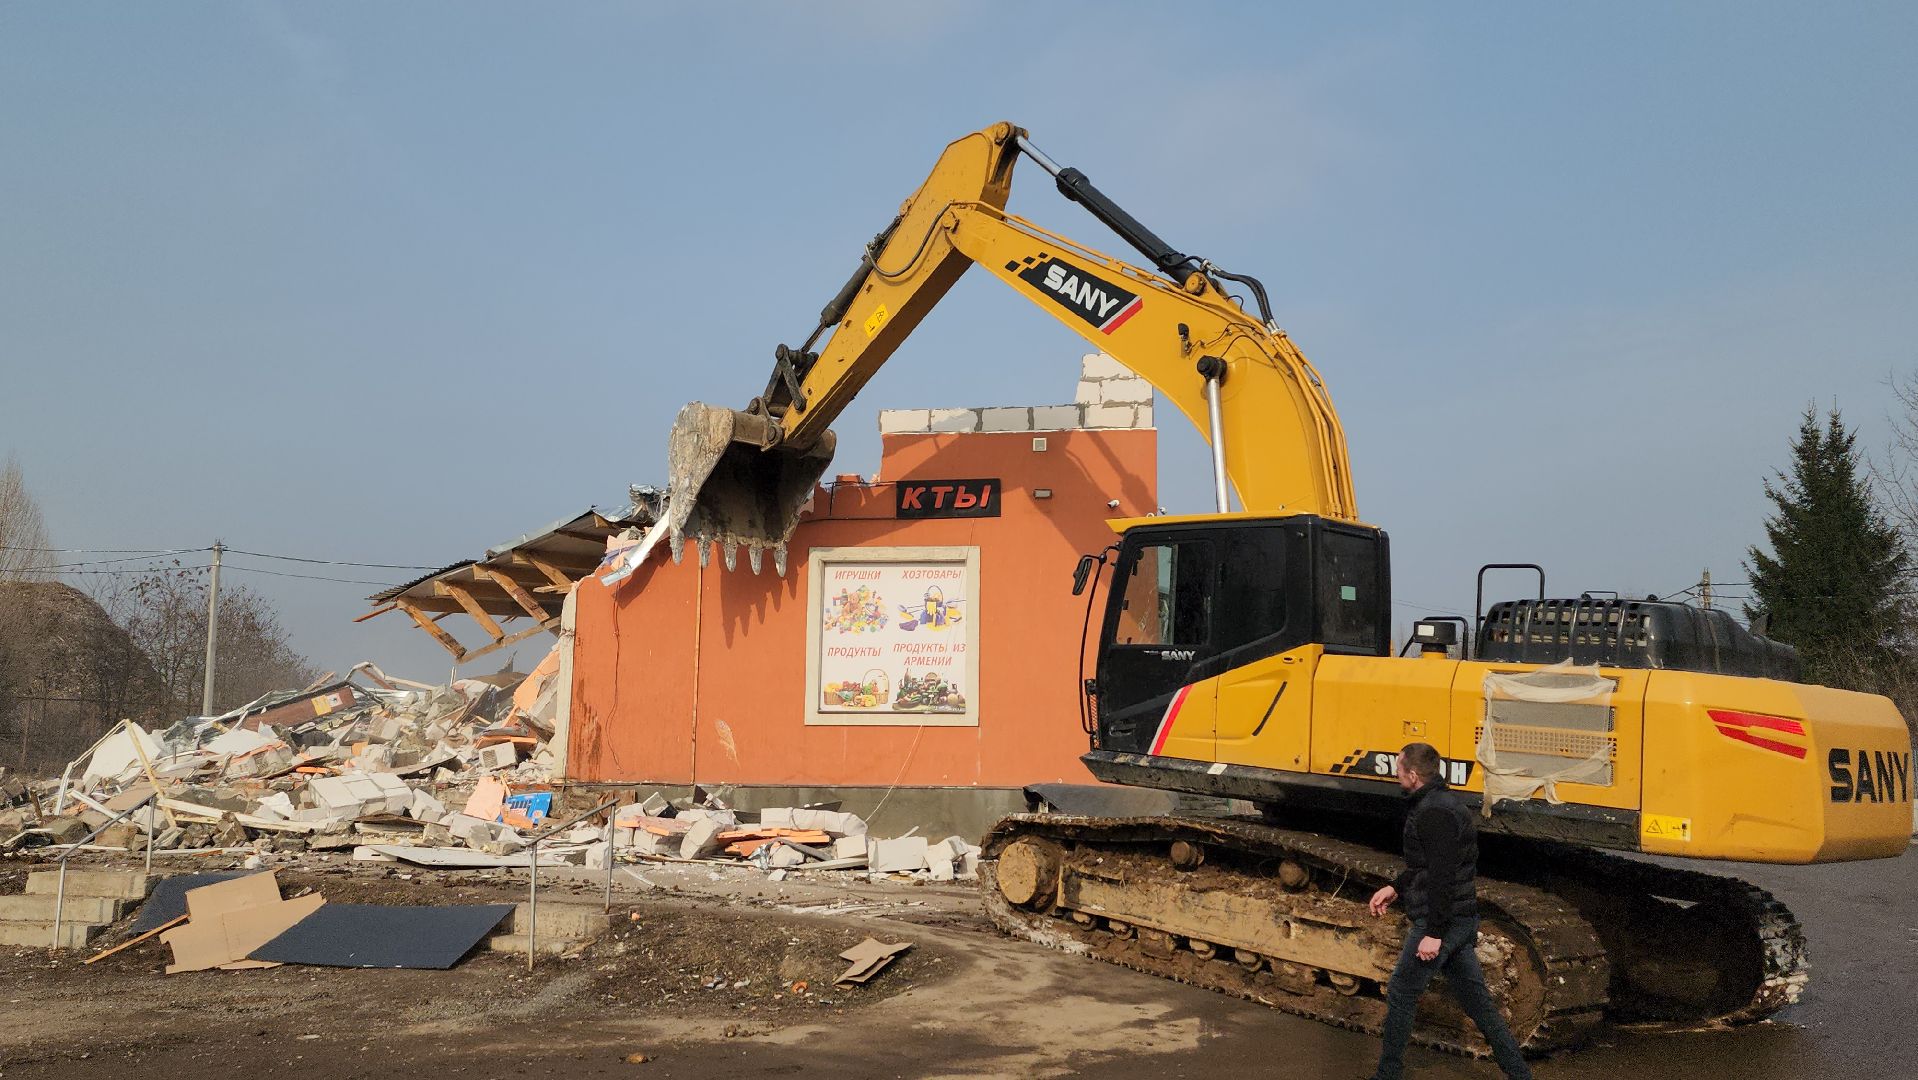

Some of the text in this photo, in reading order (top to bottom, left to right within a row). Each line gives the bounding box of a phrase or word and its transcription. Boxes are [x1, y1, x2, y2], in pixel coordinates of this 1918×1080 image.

[1043, 263, 1120, 318] SANY
[901, 484, 992, 510] КТЫ
[834, 570, 881, 580] ИГРУШКИ
[902, 569, 962, 580] ХОЗТОВАРЫ
[827, 647, 881, 658] ПРОДУКТЫ
[893, 643, 966, 655] ПРОДУКТЫ ИЗ
[1161, 650, 1196, 661] SANY
[904, 656, 952, 667] АРМЕНИИ
[1828, 747, 1908, 803] SANY
